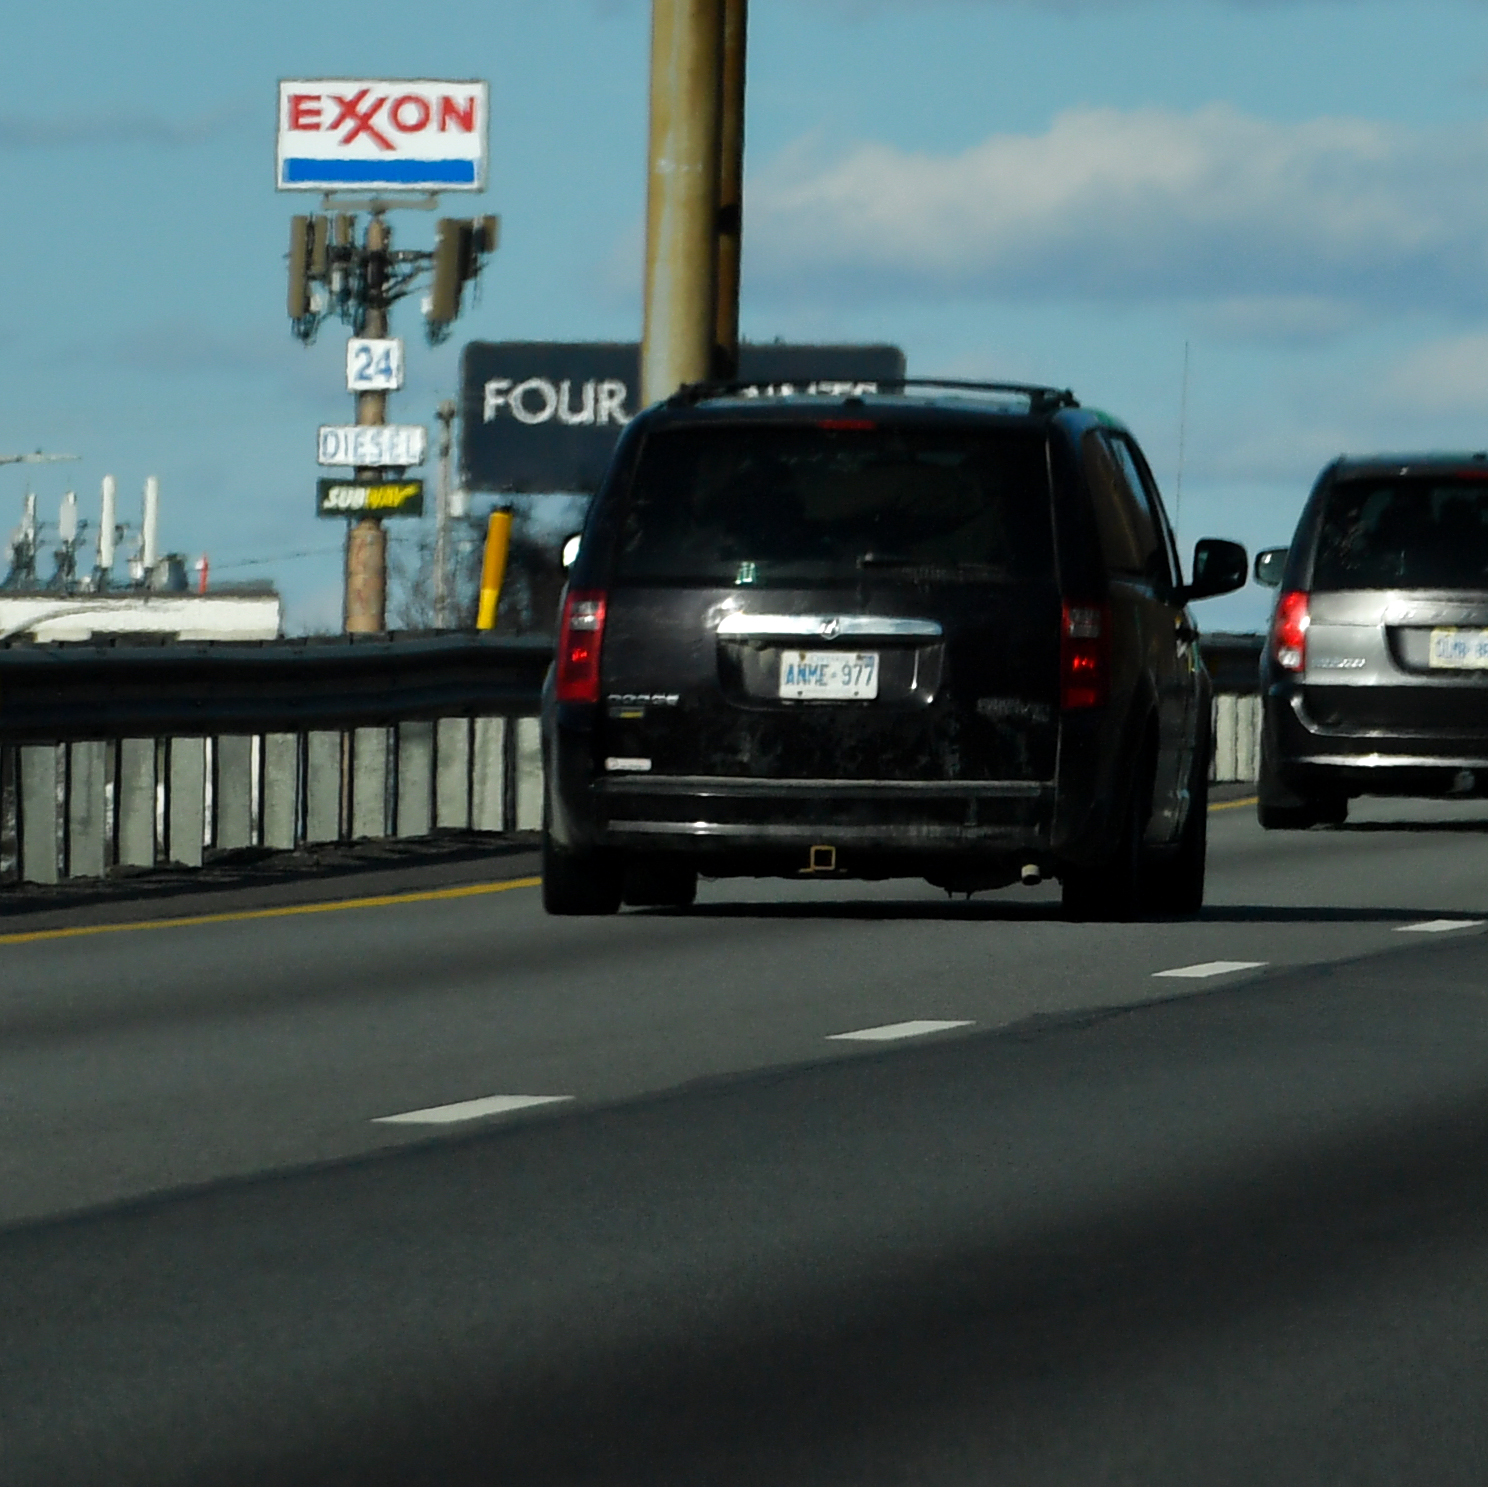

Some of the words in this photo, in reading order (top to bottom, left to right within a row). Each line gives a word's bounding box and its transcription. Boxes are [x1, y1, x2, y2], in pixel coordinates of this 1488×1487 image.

[287, 88, 476, 152] EXXON
[354, 345, 394, 382] 24
[482, 377, 636, 426] FOUR
